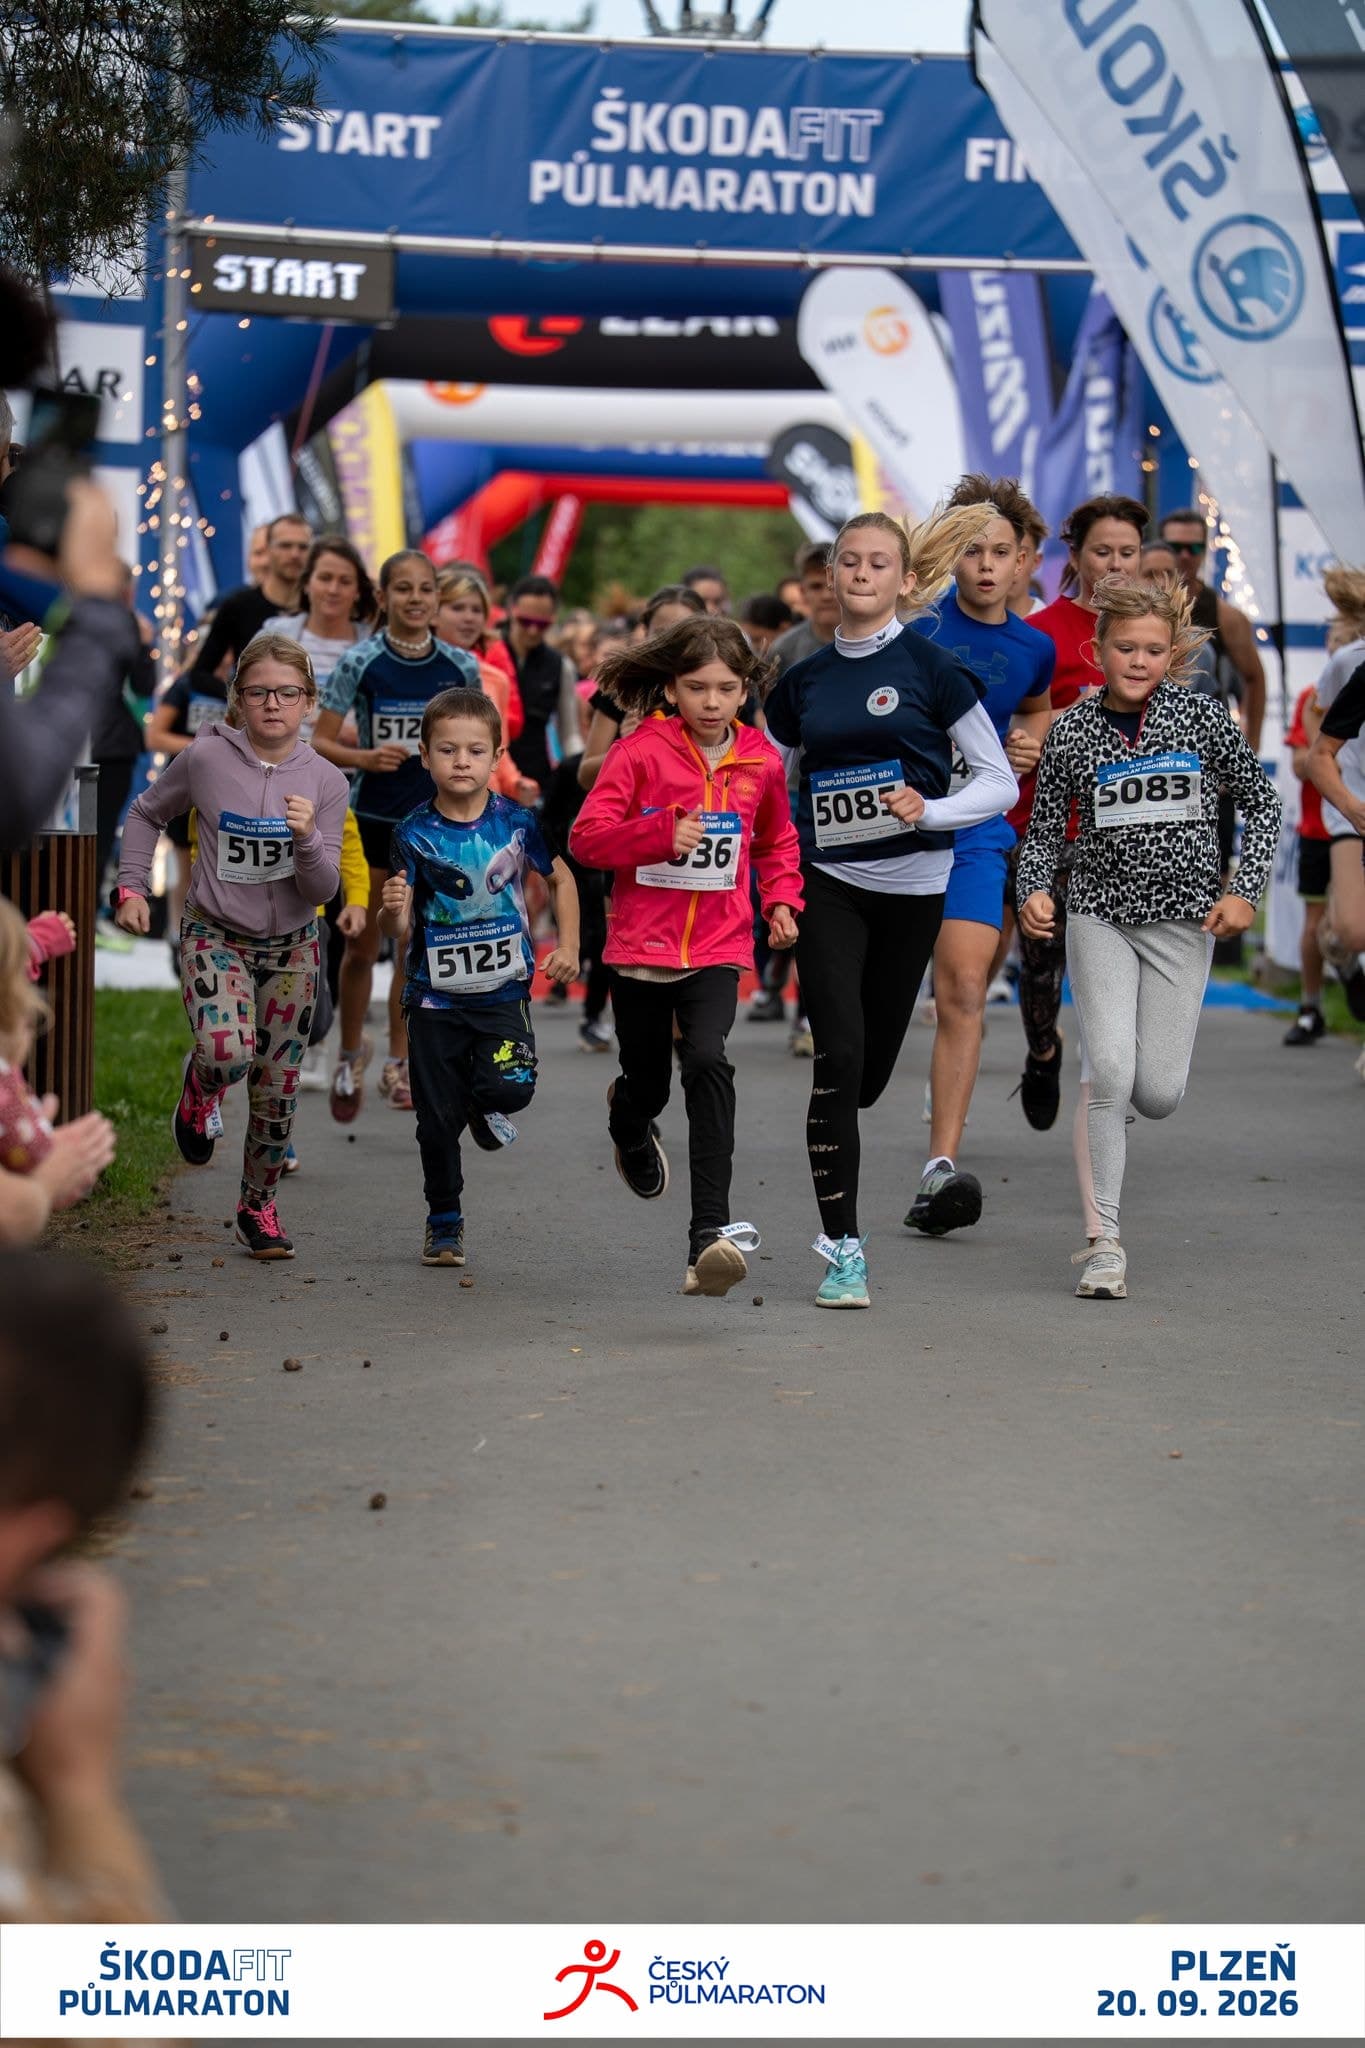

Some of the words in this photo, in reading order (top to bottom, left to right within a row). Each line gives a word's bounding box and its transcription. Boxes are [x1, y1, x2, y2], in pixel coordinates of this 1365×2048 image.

[277, 105, 442, 160] START
[591, 87, 885, 163] ŠKODAFIT
[530, 150, 877, 217] PŮLMARATON
[213, 254, 368, 301] START
[1098, 774, 1191, 807] 5083
[437, 938, 512, 979] 5125
